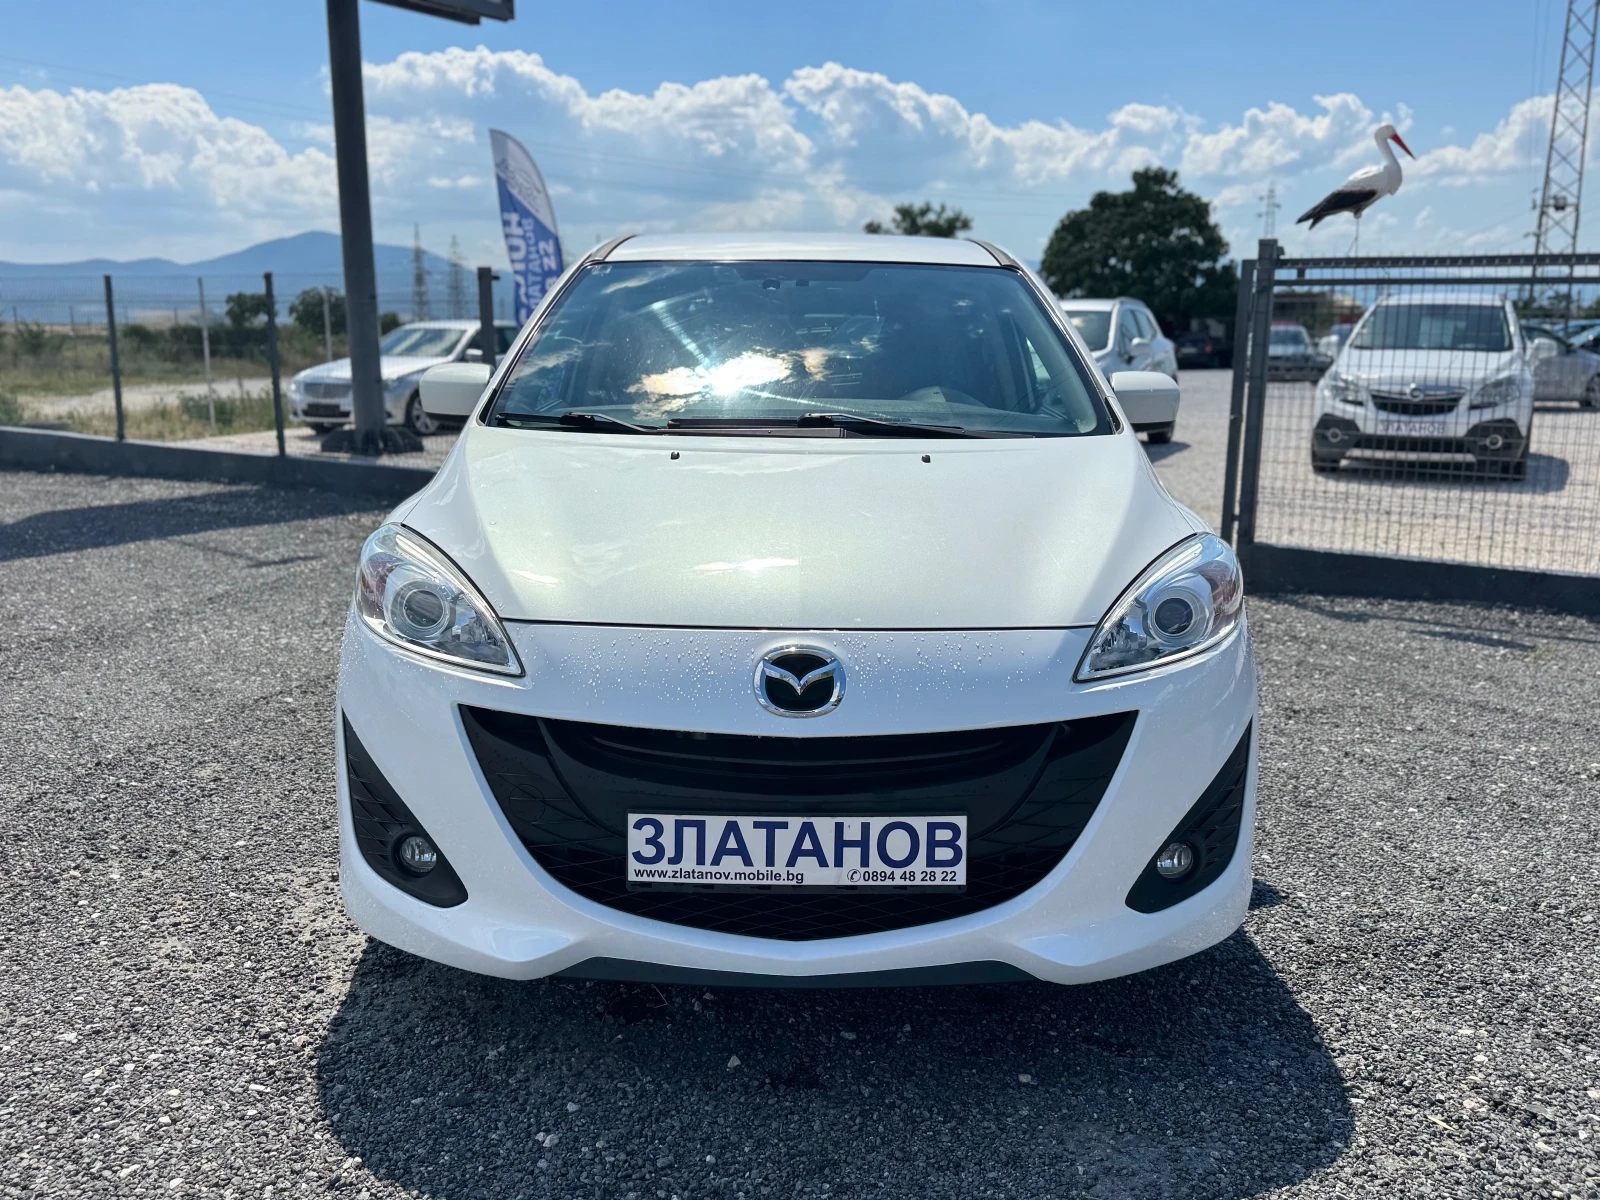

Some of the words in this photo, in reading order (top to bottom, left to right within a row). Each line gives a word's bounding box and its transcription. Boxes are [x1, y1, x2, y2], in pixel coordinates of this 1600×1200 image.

[538, 240, 557, 271] 22
[631, 817, 963, 869] ЗЛАТАНОВ
[634, 868, 804, 883] www.zlatanov.mobile.bg
[862, 870, 896, 882] 0894
[899, 870, 916, 882] 48
[920, 870, 937, 882] 28
[940, 870, 957, 882] 22
